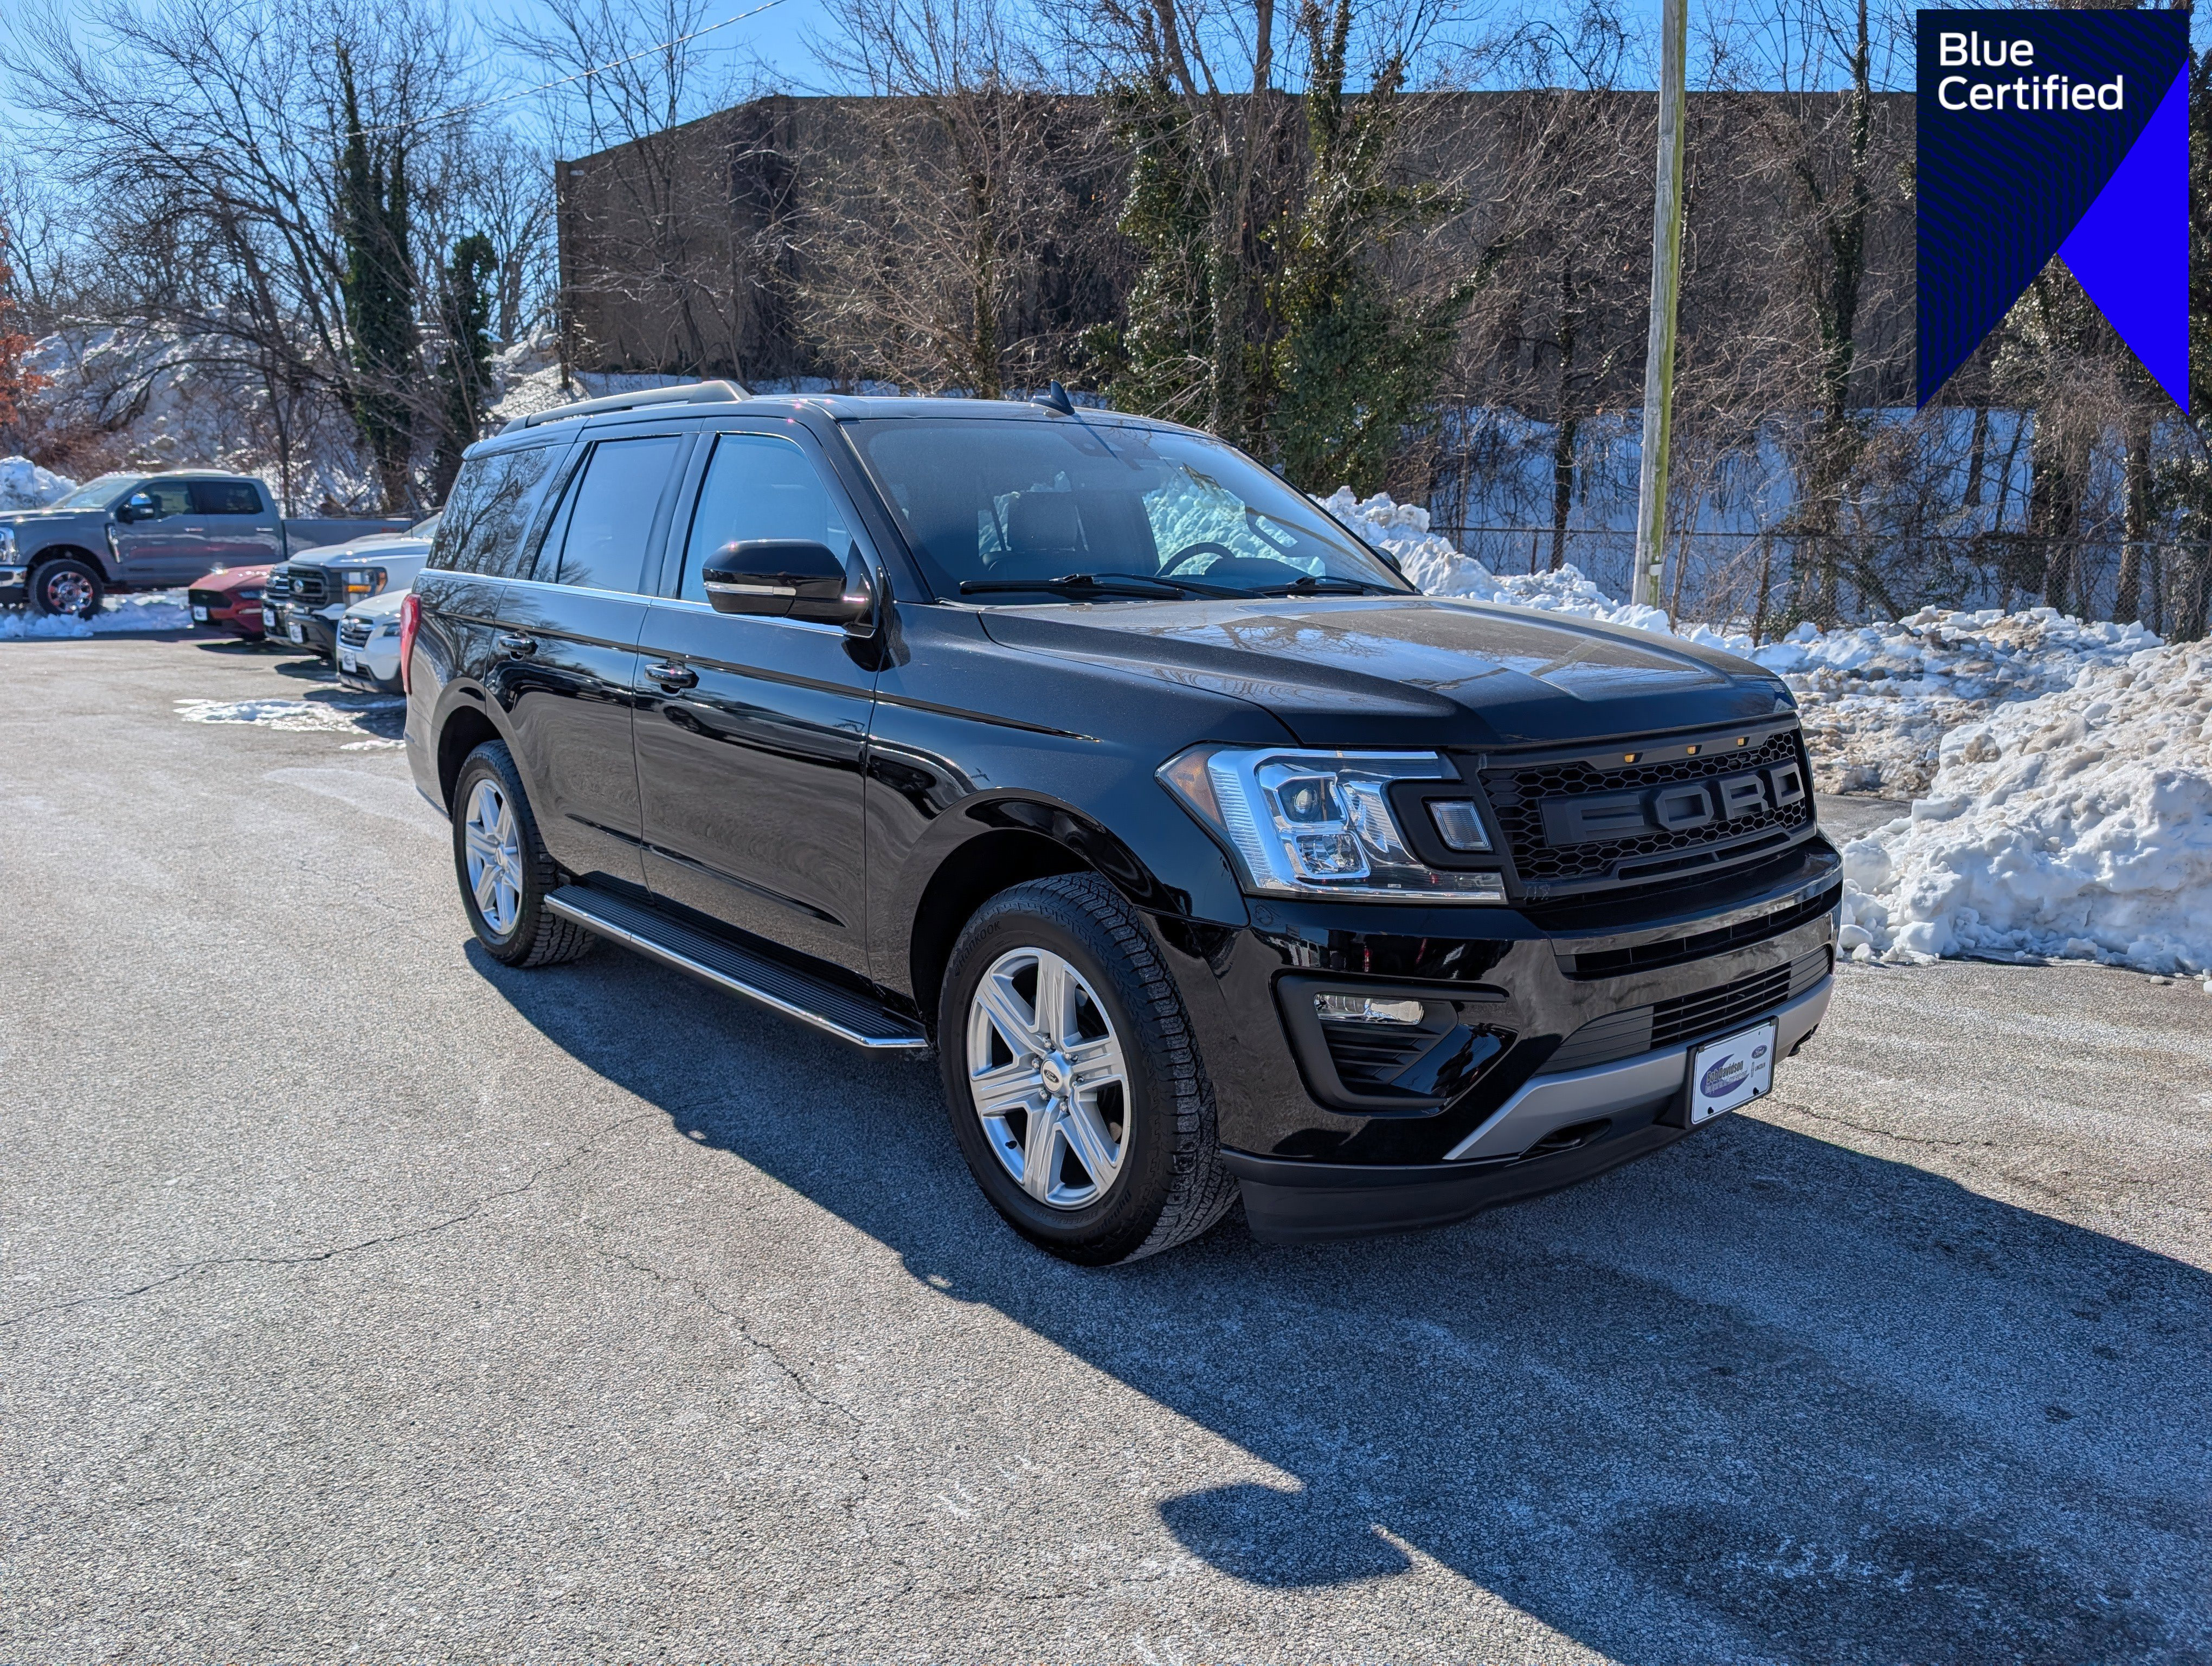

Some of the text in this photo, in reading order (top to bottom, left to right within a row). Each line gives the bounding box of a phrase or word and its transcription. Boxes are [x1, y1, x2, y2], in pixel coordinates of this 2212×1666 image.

[1541, 762, 1805, 846] FORD
[1707, 1068, 1719, 1084] Bob
[1719, 1060, 1744, 1078] Davidson
